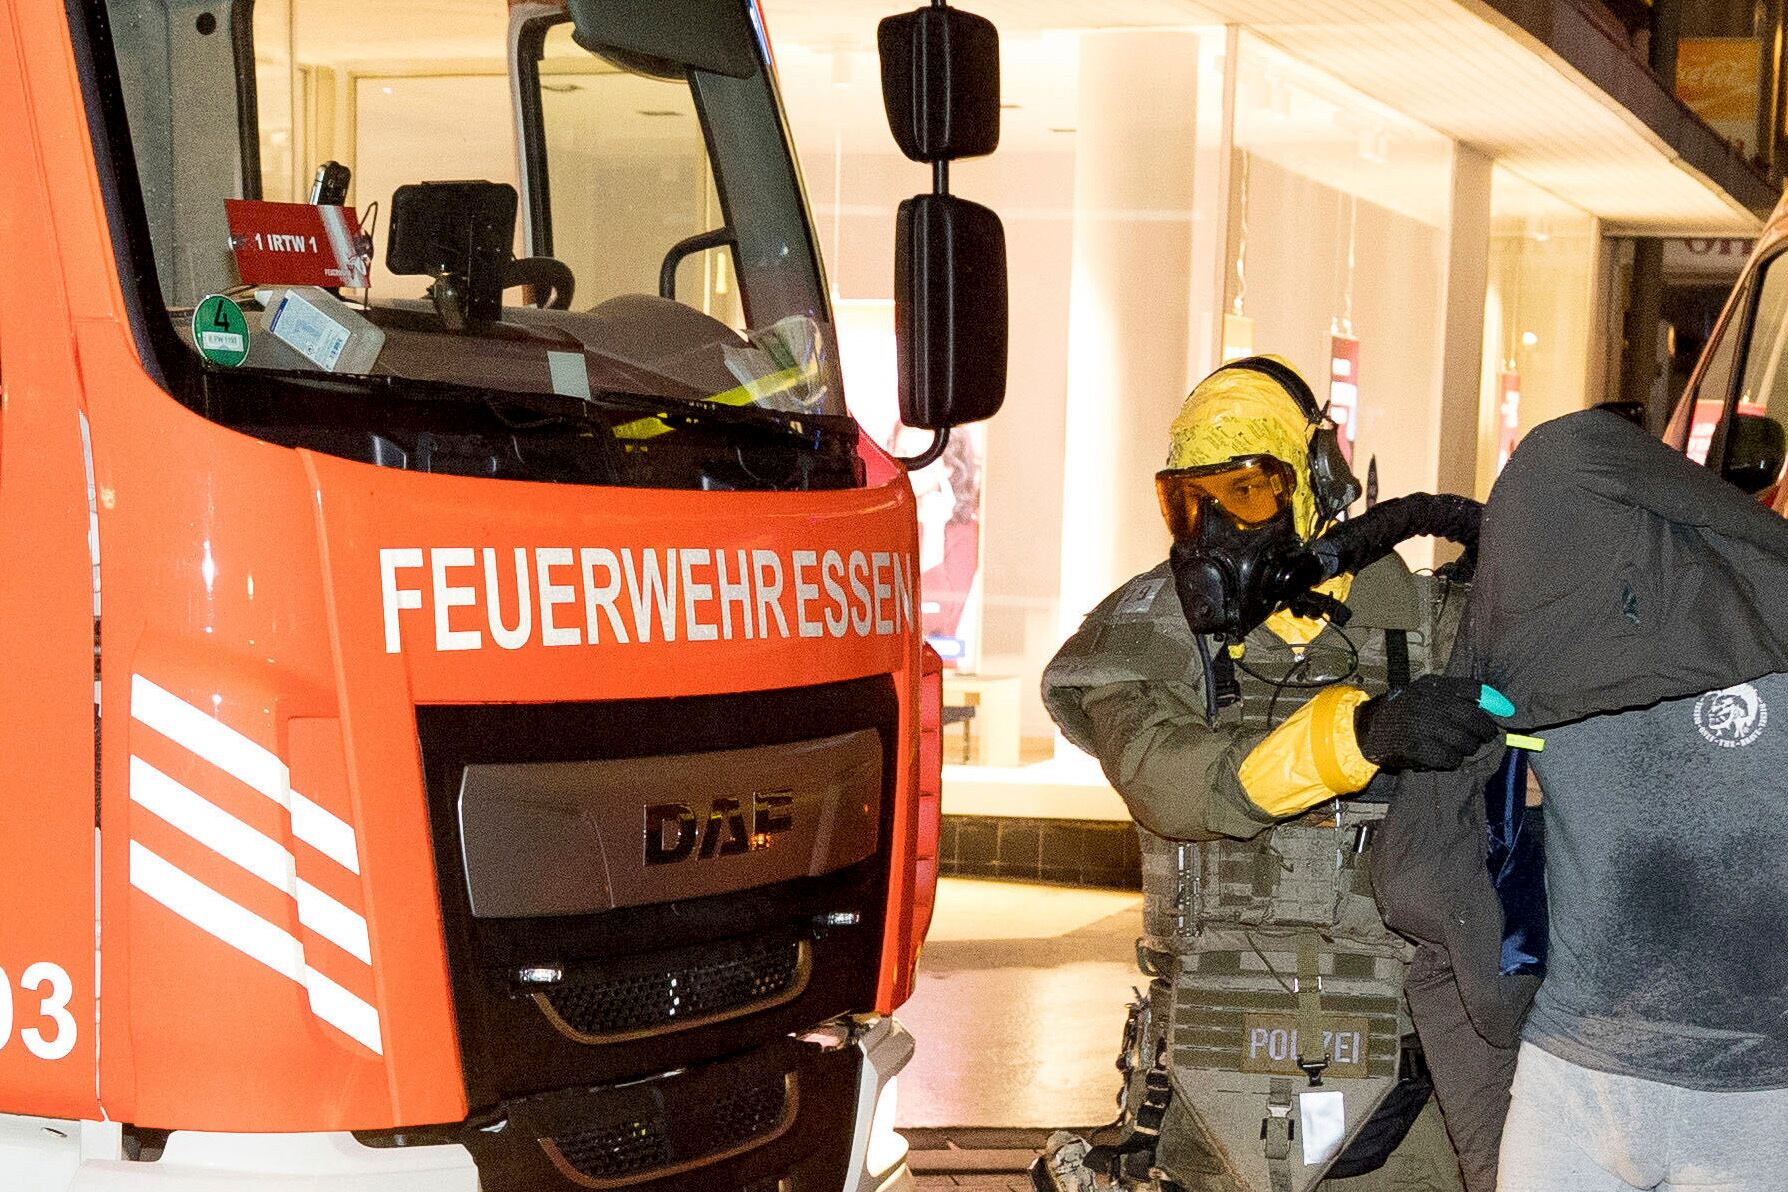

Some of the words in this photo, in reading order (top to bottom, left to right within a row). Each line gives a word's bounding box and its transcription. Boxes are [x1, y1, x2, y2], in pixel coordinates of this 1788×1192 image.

[255, 232, 264, 251] 1
[267, 233, 306, 253] IRTW
[309, 236, 318, 254] 1
[213, 300, 229, 332] 4
[379, 547, 790, 654] FEUERWEHR
[793, 549, 914, 640] ESSEN
[643, 789, 794, 867] DAF
